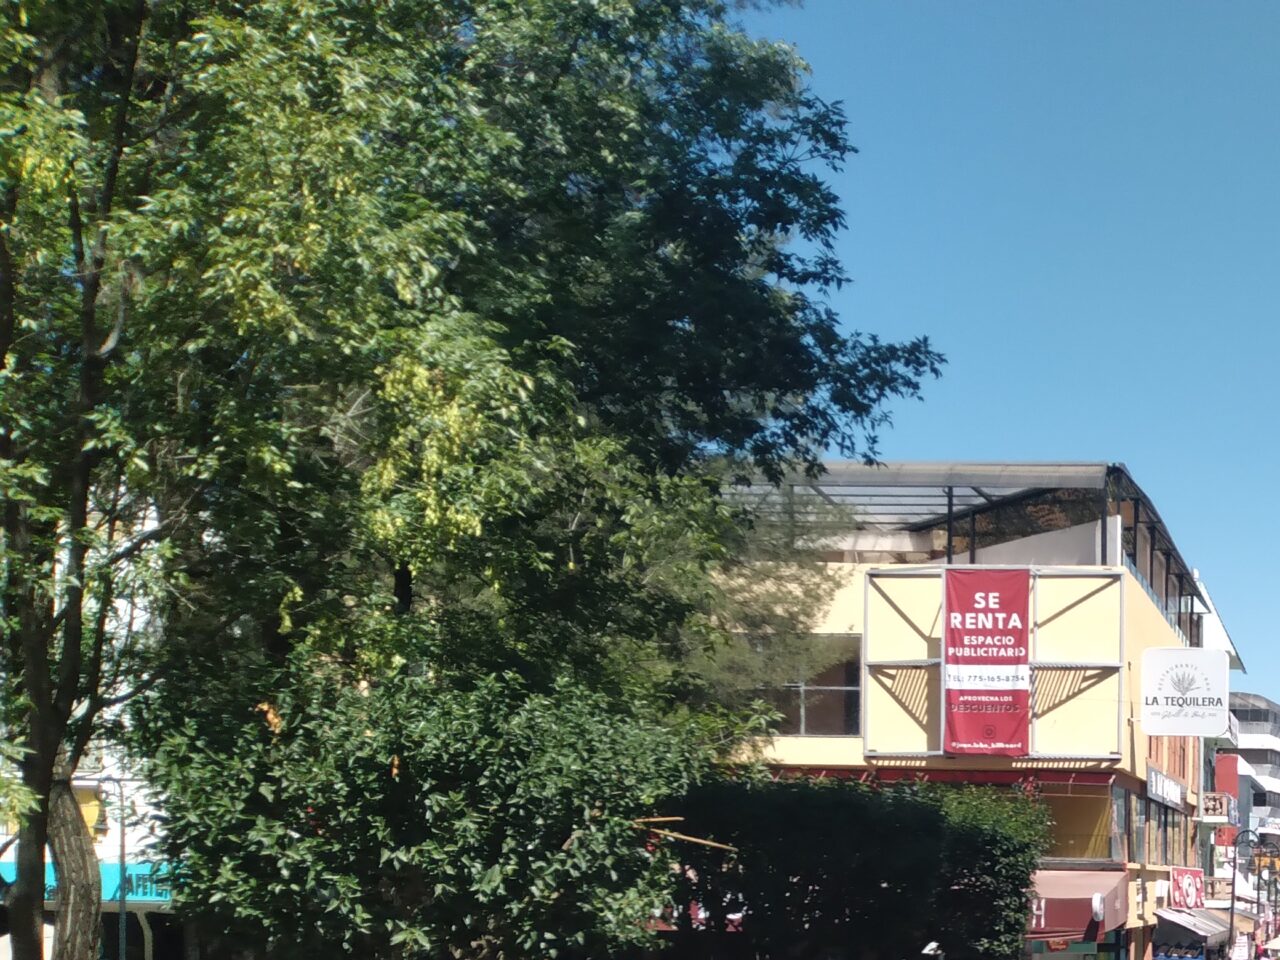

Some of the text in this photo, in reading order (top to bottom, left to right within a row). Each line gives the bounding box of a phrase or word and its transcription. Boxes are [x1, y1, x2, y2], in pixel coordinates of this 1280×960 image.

[973, 592, 1000, 609] SE
[950, 612, 1023, 630] RENTA
[963, 635, 1015, 646] ESPACIO
[947, 646, 1026, 657] PUBLICITARIO
[1145, 696, 1223, 708] LA TEQUILERA
[951, 704, 1020, 713] DESCUENTOS
